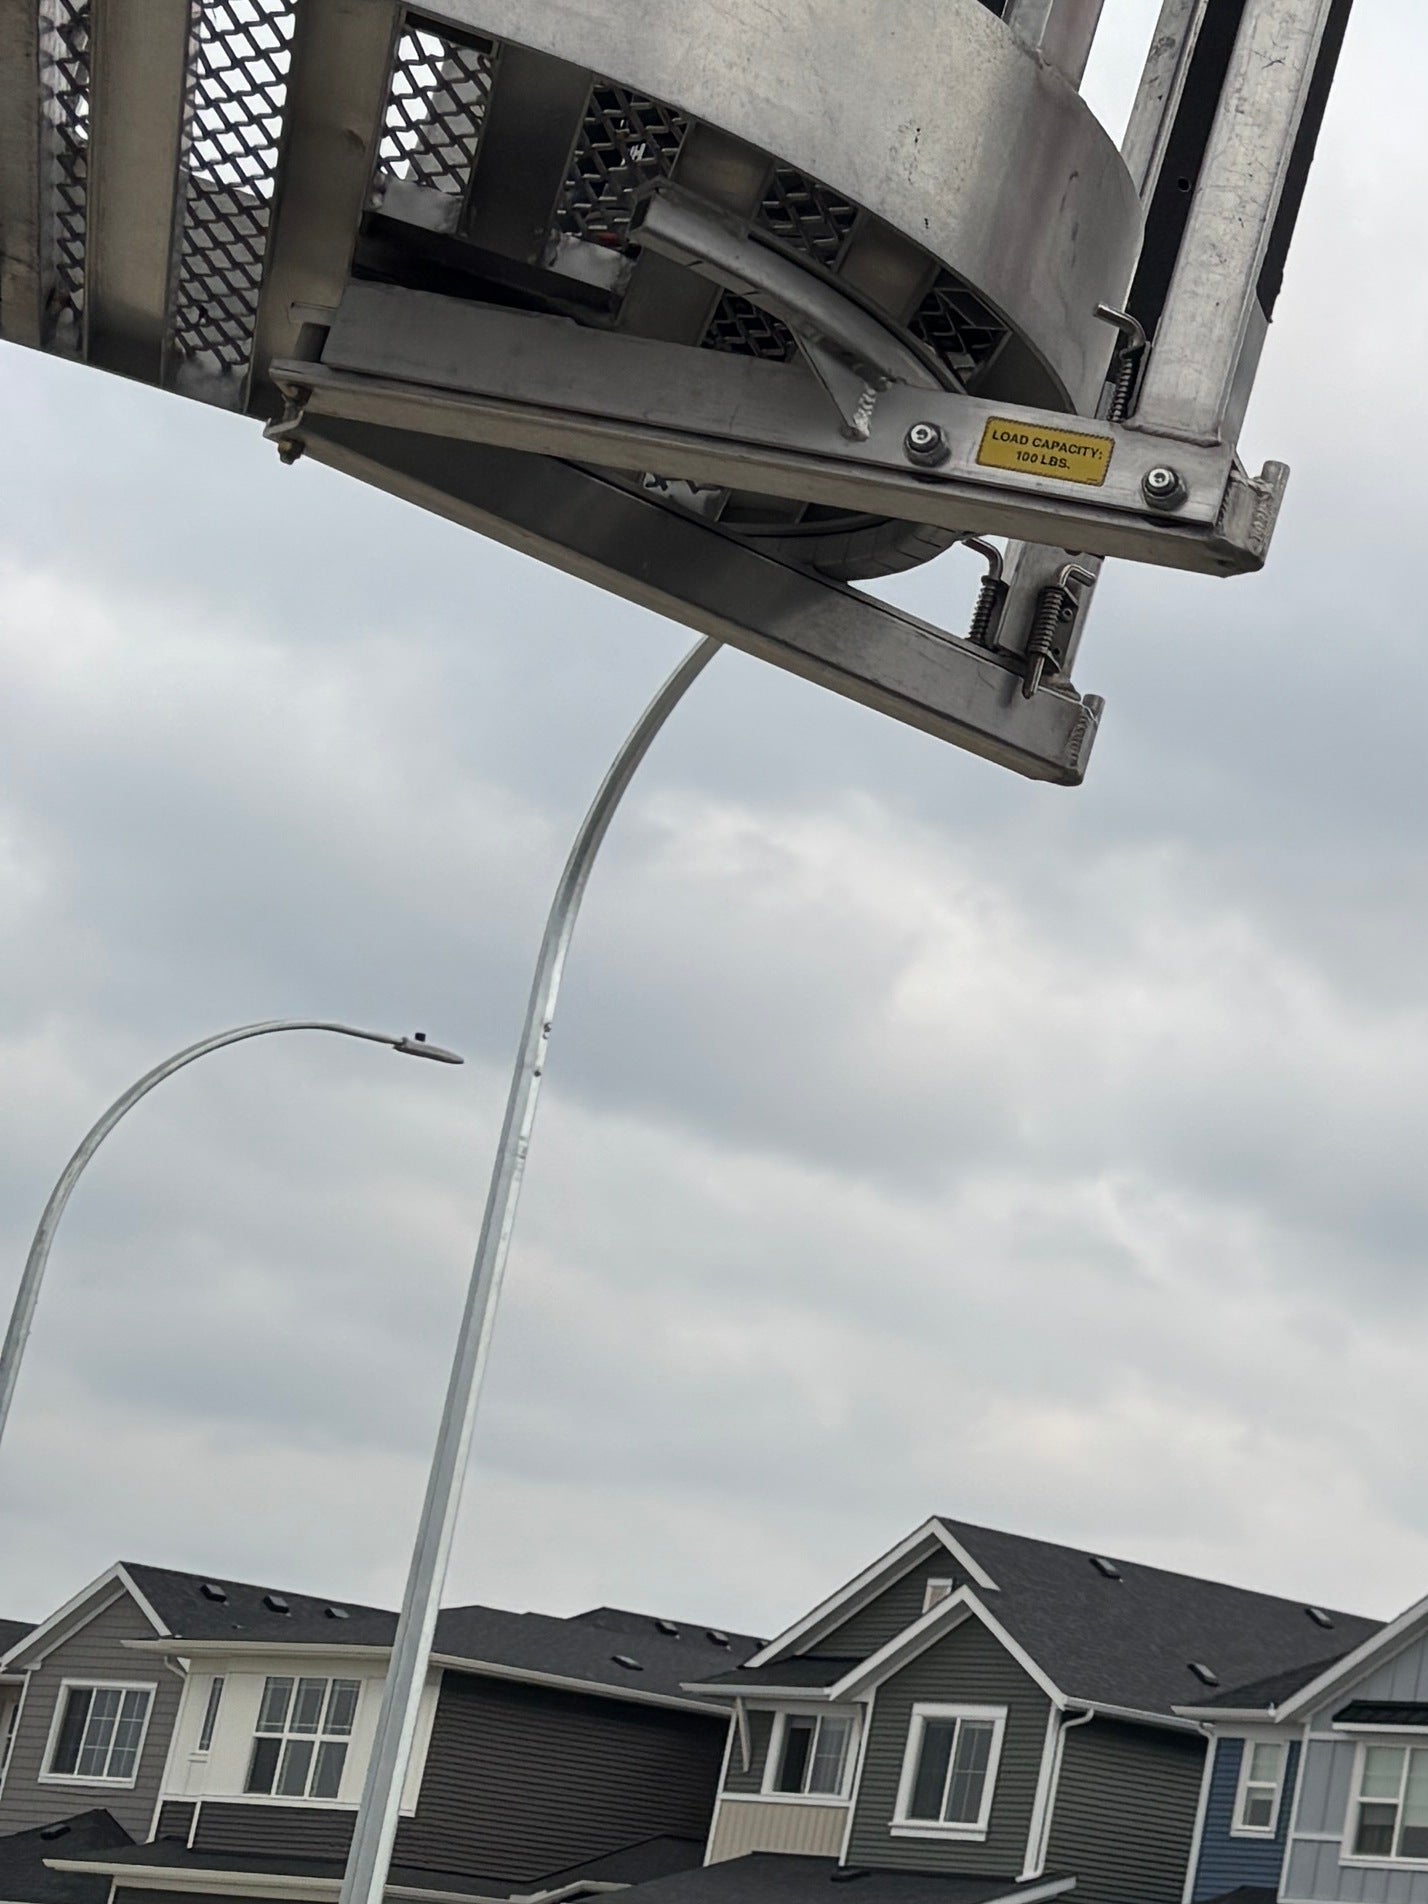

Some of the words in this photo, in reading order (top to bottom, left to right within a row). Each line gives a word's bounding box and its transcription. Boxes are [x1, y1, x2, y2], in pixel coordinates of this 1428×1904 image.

[992, 430, 1029, 446] LOAD
[1032, 437, 1104, 460] CAPACITY:
[1016, 450, 1039, 464] 100
[1041, 454, 1071, 470] LBS.
